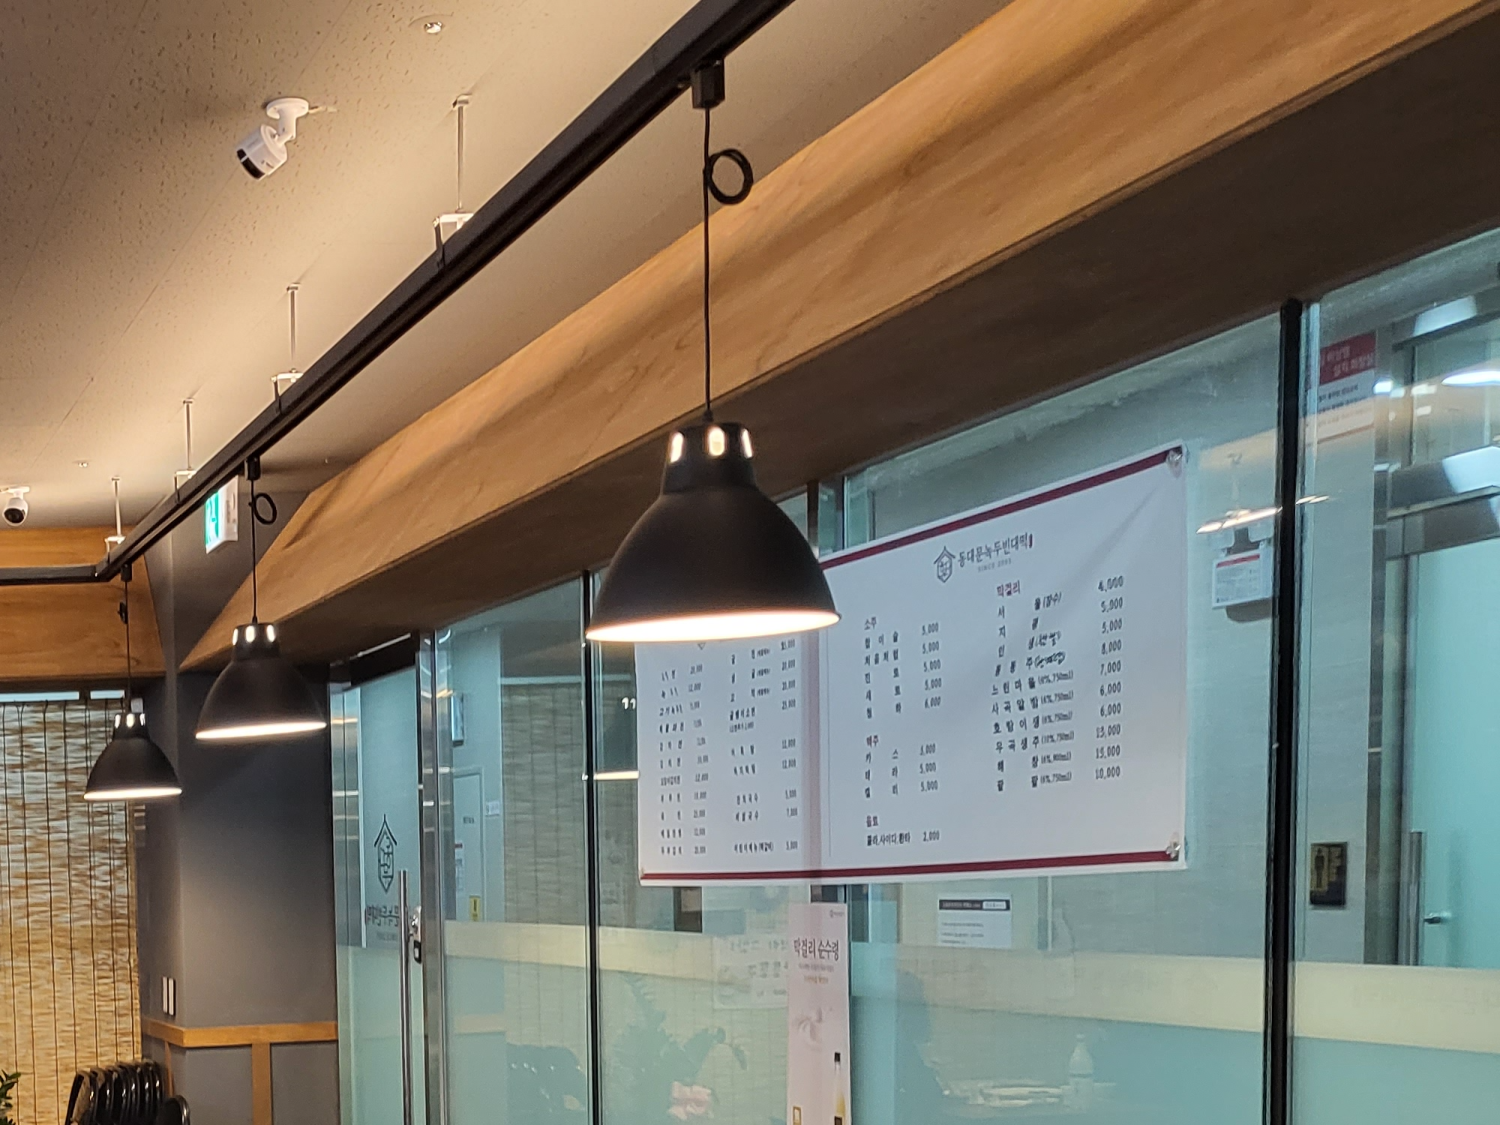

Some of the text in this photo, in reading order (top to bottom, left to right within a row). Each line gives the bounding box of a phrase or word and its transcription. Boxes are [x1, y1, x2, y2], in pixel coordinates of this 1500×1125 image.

[1101, 597, 1123, 612] 5,000
[1102, 618, 1123, 634] 5,000
[1100, 660, 1122, 675] 7,000
[1100, 681, 1122, 697] 6,000
[1100, 702, 1122, 717] 6,000
[1096, 723, 1121, 739] 13,000
[1095, 745, 1121, 759] 15,000
[793, 937, 817, 959] 막걸리
